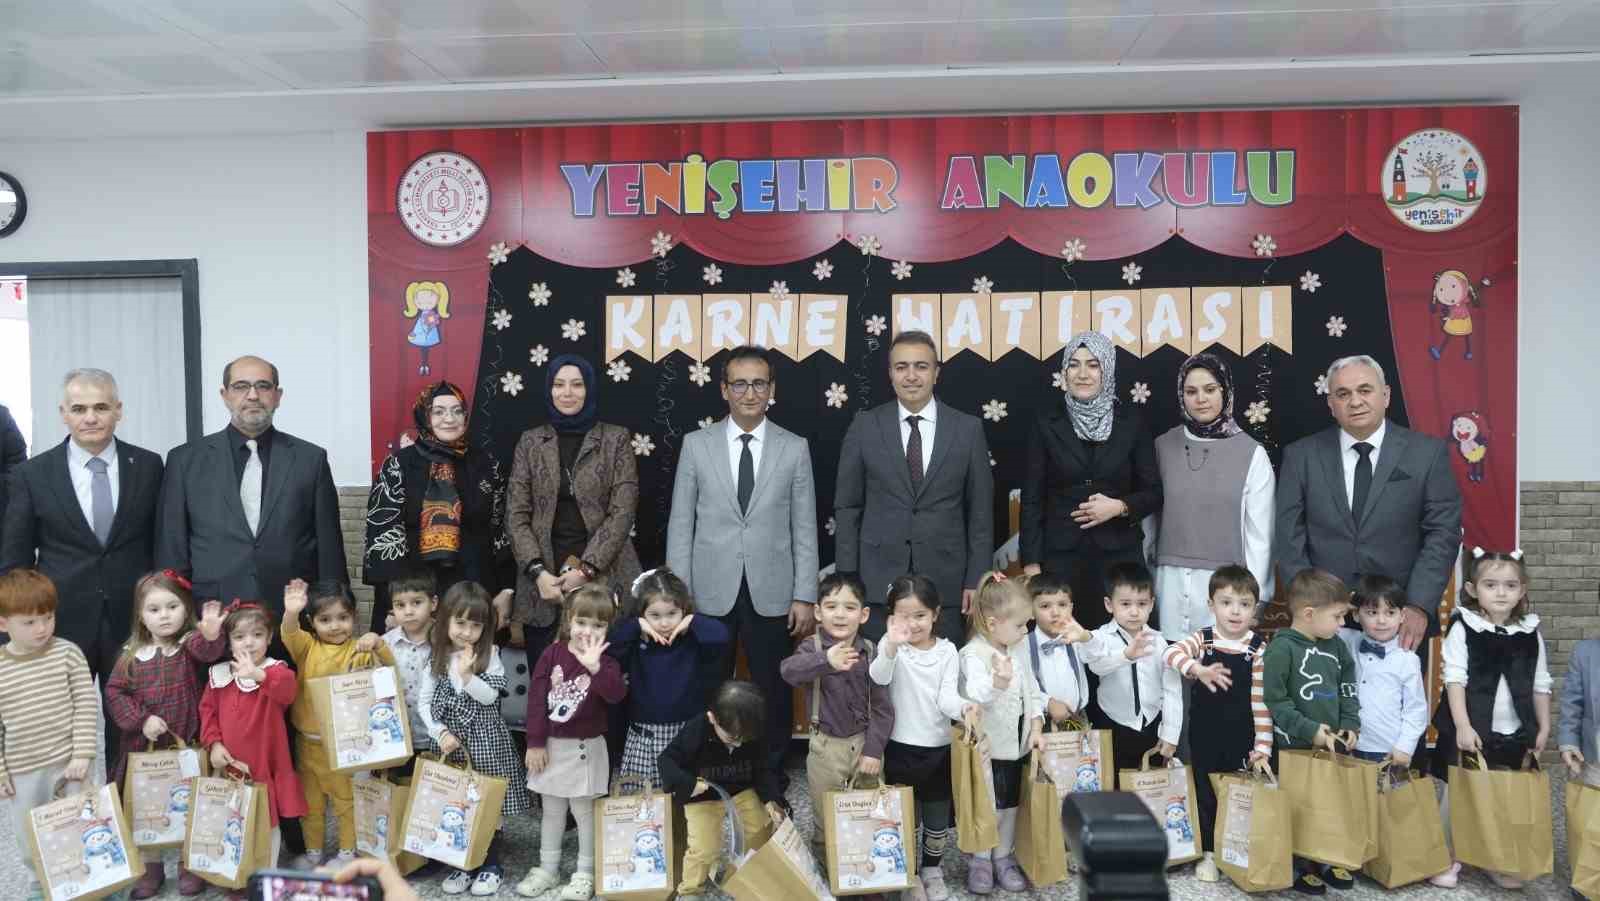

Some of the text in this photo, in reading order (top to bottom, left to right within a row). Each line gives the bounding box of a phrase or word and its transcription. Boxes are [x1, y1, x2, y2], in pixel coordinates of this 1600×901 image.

[559, 150, 1296, 220] YENİŞEHİR ANAOKULU
[609, 290, 1273, 350] KARNE HATIRASI
